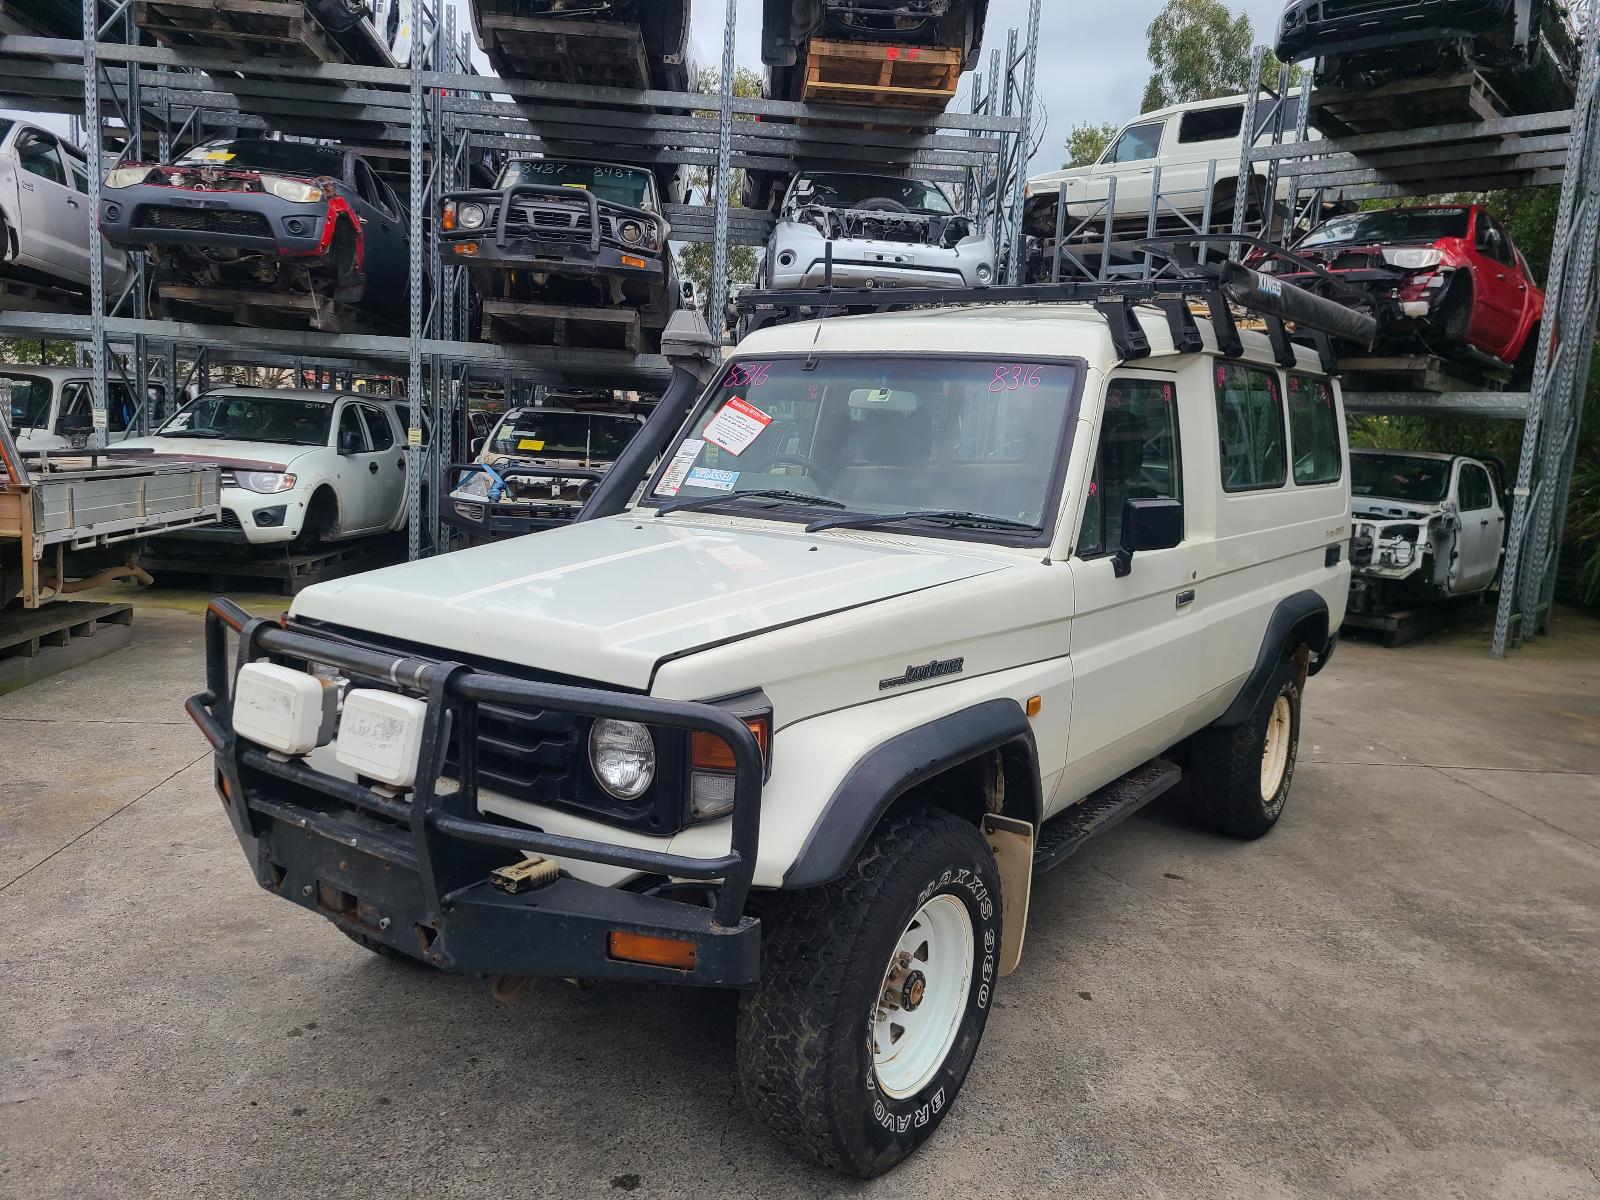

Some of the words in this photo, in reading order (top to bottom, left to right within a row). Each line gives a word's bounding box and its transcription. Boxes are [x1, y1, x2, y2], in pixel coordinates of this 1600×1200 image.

[521, 162, 568, 174] 8487
[593, 167, 633, 178] 8487
[1257, 273, 1282, 297] KINGS
[723, 361, 773, 388] 8316
[988, 366, 1044, 392] 8316
[917, 868, 993, 921] MAXXIS
[978, 928, 995, 1009] 980
[873, 1086, 946, 1133] BRAVO
